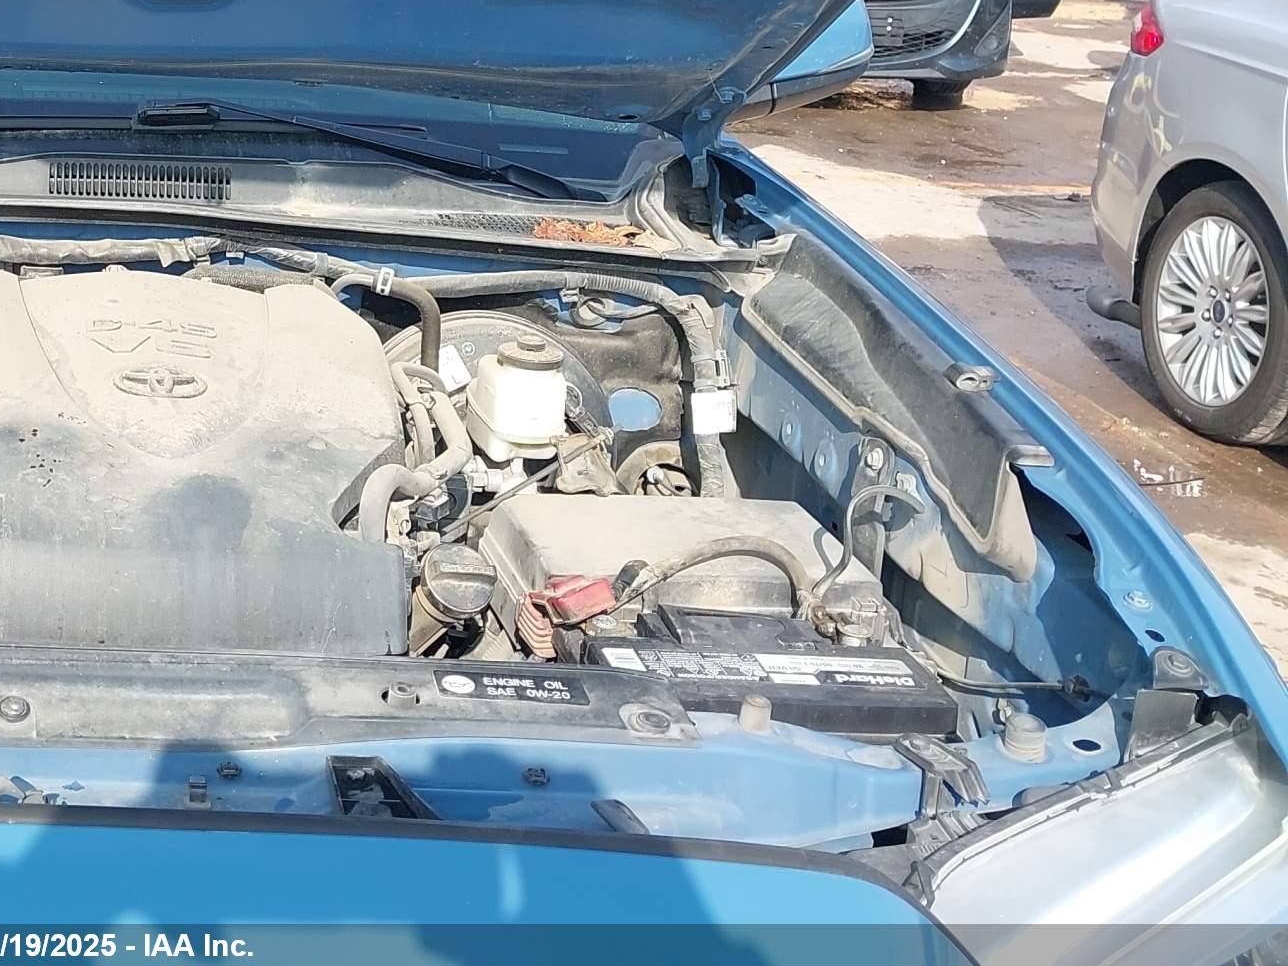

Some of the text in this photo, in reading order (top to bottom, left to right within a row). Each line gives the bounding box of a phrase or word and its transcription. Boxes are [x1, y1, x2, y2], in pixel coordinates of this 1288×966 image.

[483, 676, 536, 688] ENGINE
[543, 680, 569, 690] OIL
[834, 673, 916, 687] DieHard
[487, 687, 571, 700] SAE 0W-20
